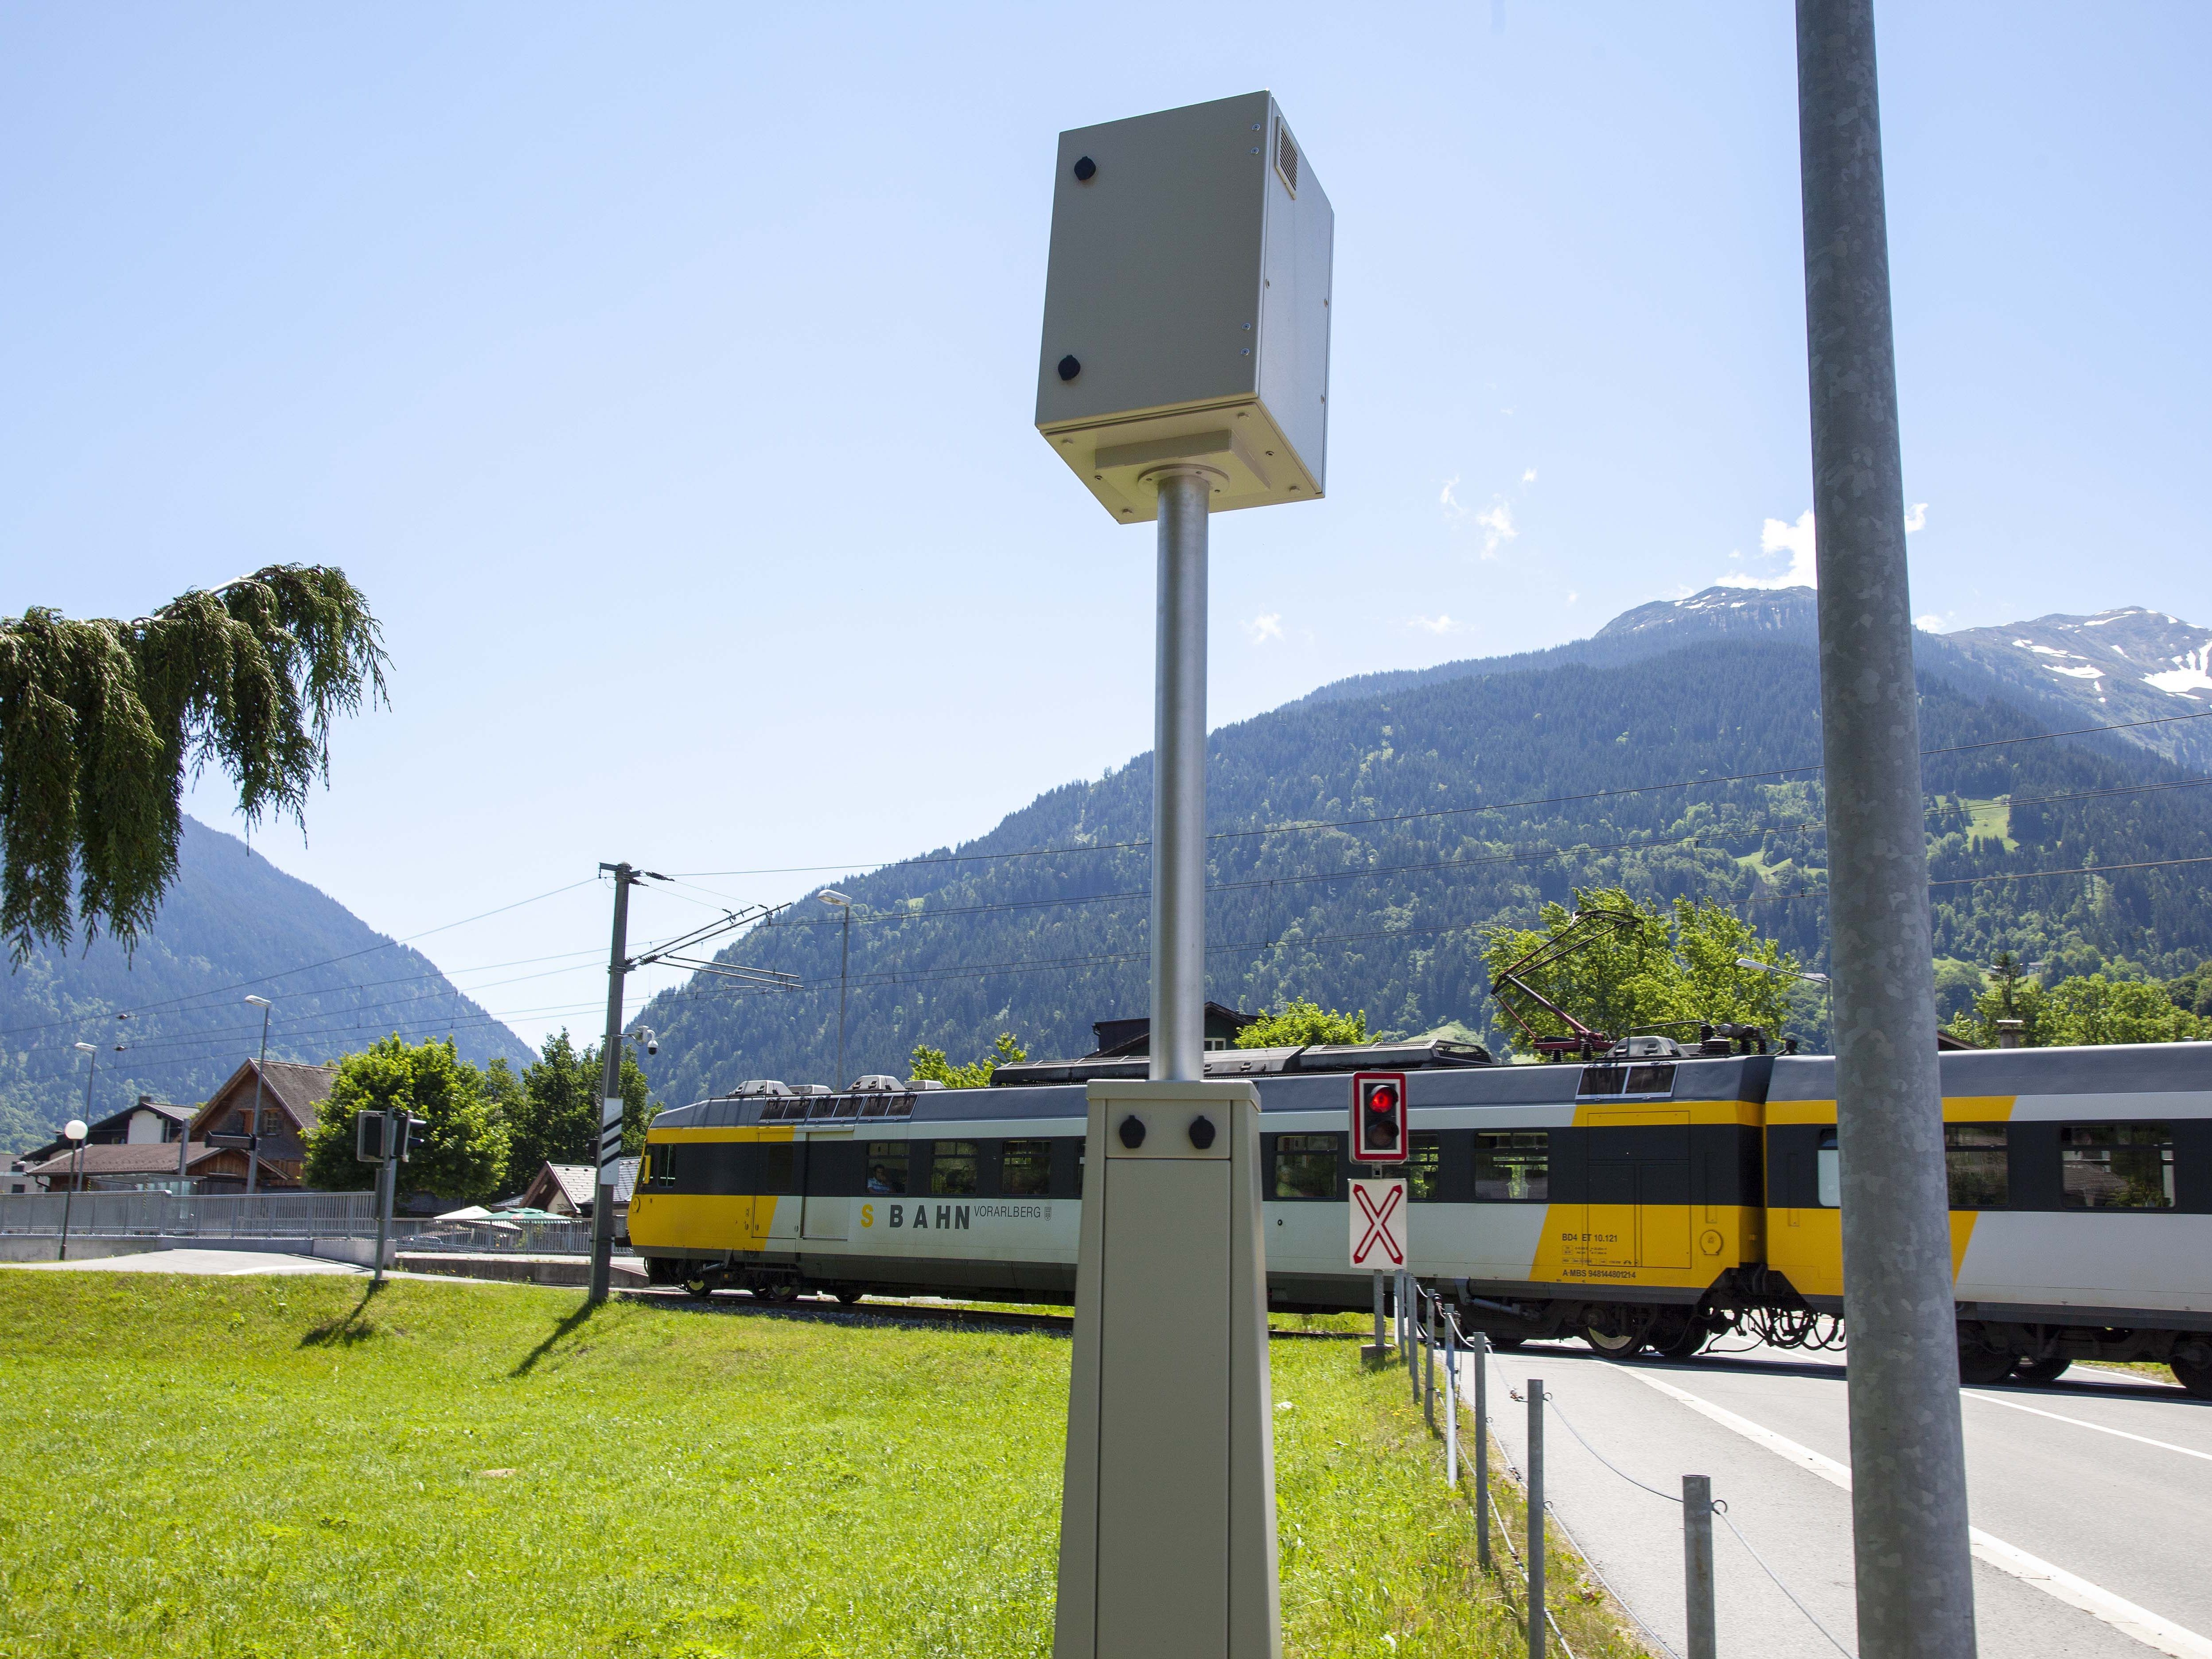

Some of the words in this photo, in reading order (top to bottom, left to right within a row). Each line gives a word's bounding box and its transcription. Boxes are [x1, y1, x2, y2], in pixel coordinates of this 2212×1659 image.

[861, 1203, 874, 1228] S
[889, 1204, 970, 1230] BAHN
[974, 1205, 1041, 1218] VORARLBERG
